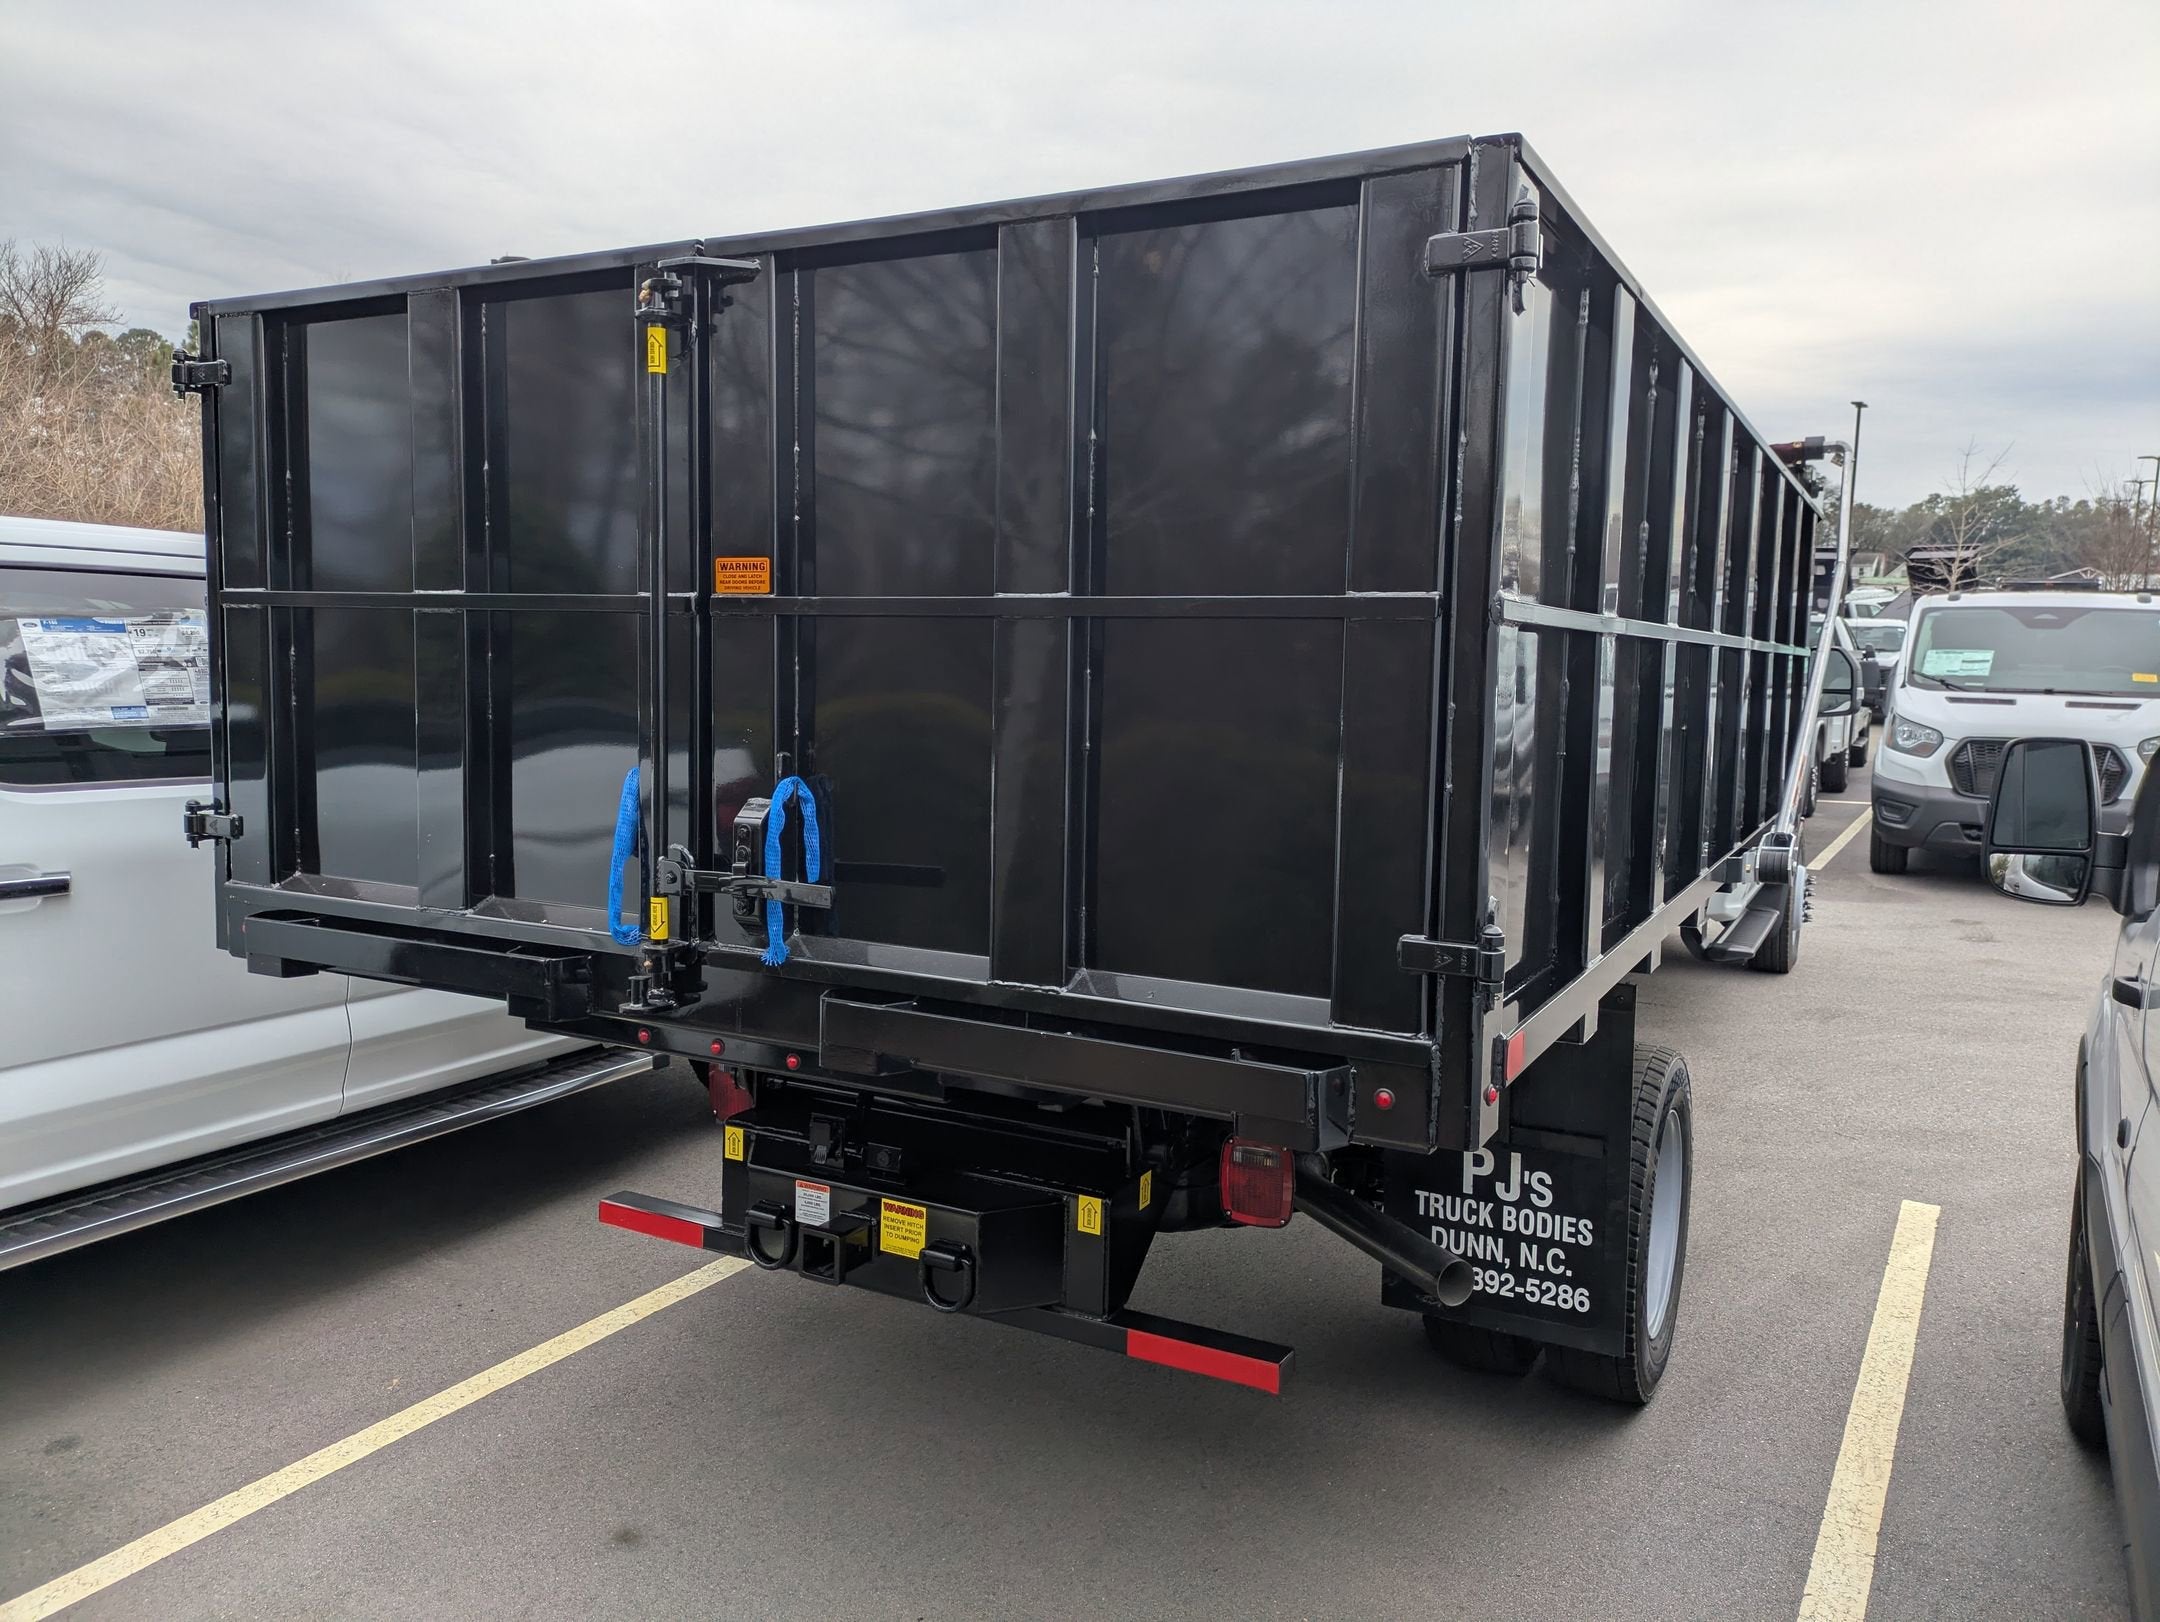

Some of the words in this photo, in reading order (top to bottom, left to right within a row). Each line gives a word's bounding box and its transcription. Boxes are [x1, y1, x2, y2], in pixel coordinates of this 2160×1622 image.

[133, 628, 146, 637] 19
[883, 1202, 924, 1219] WARNING
[1414, 1189, 1494, 1229] TRUCK
[1502, 1205, 1593, 1246] BODIES
[883, 1215, 906, 1226] REMOVE
[906, 1220, 924, 1230] HITCH
[884, 1223, 904, 1233] INSERT
[904, 1227, 922, 1237] PRIOR
[894, 1233, 920, 1244] DUMPING
[1431, 1225, 1510, 1269] DUNN,
[1519, 1242, 1573, 1277] N.C.
[1472, 1267, 1590, 1313] 392-5286
